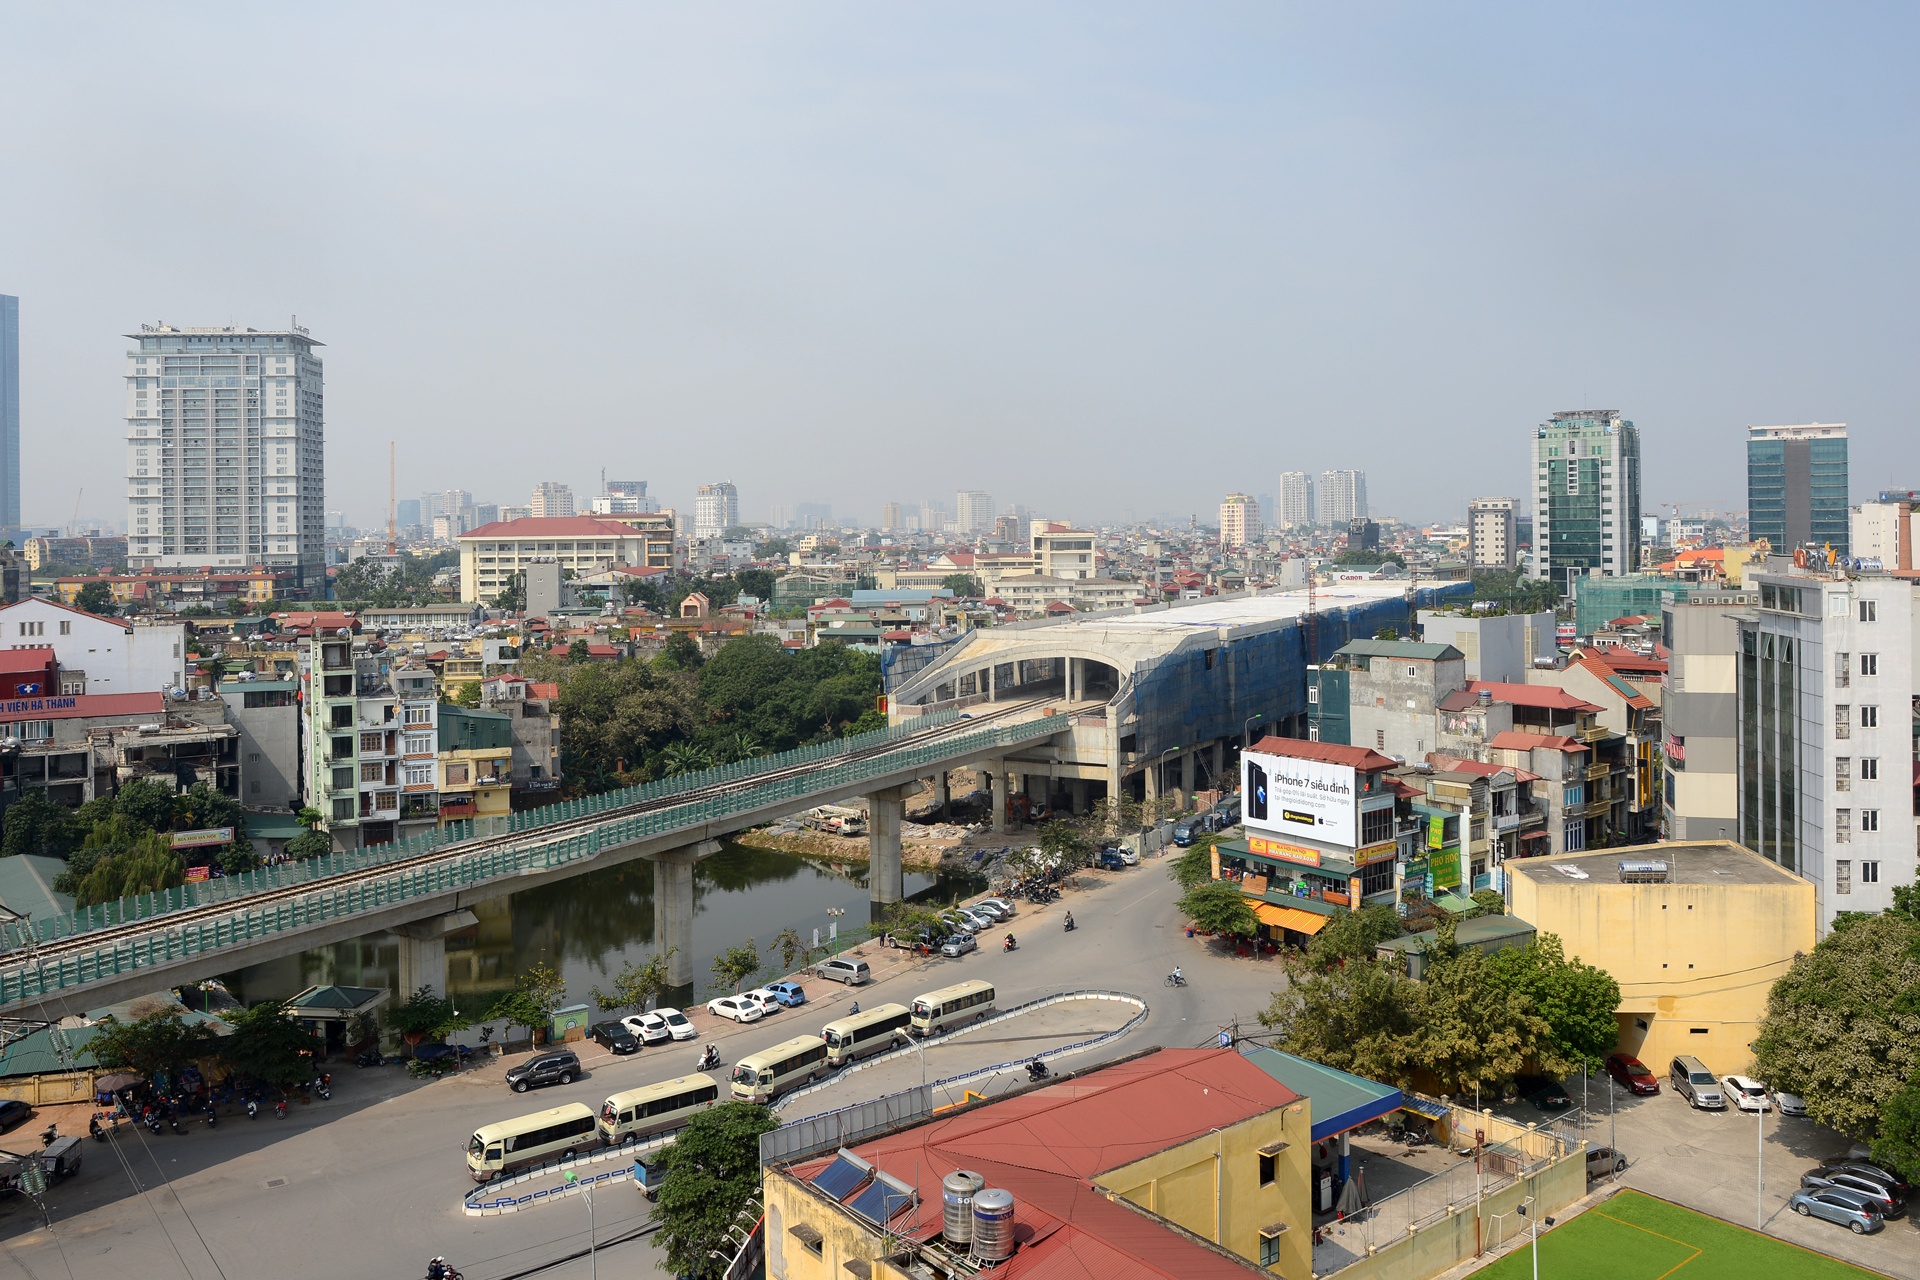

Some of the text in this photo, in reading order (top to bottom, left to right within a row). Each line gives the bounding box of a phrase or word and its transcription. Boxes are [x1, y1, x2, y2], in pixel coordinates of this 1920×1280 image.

[7, 700, 28, 713] VIỆN
[31, 698, 43, 710] HÀ
[46, 697, 75, 709] THÀNH
[1665, 741, 1685, 761] PIANO
[1274, 773, 1303, 787] iPhone
[1304, 779, 1310, 788] 7
[1310, 779, 1328, 791] siêu
[1445, 852, 1459, 864] HỌC
